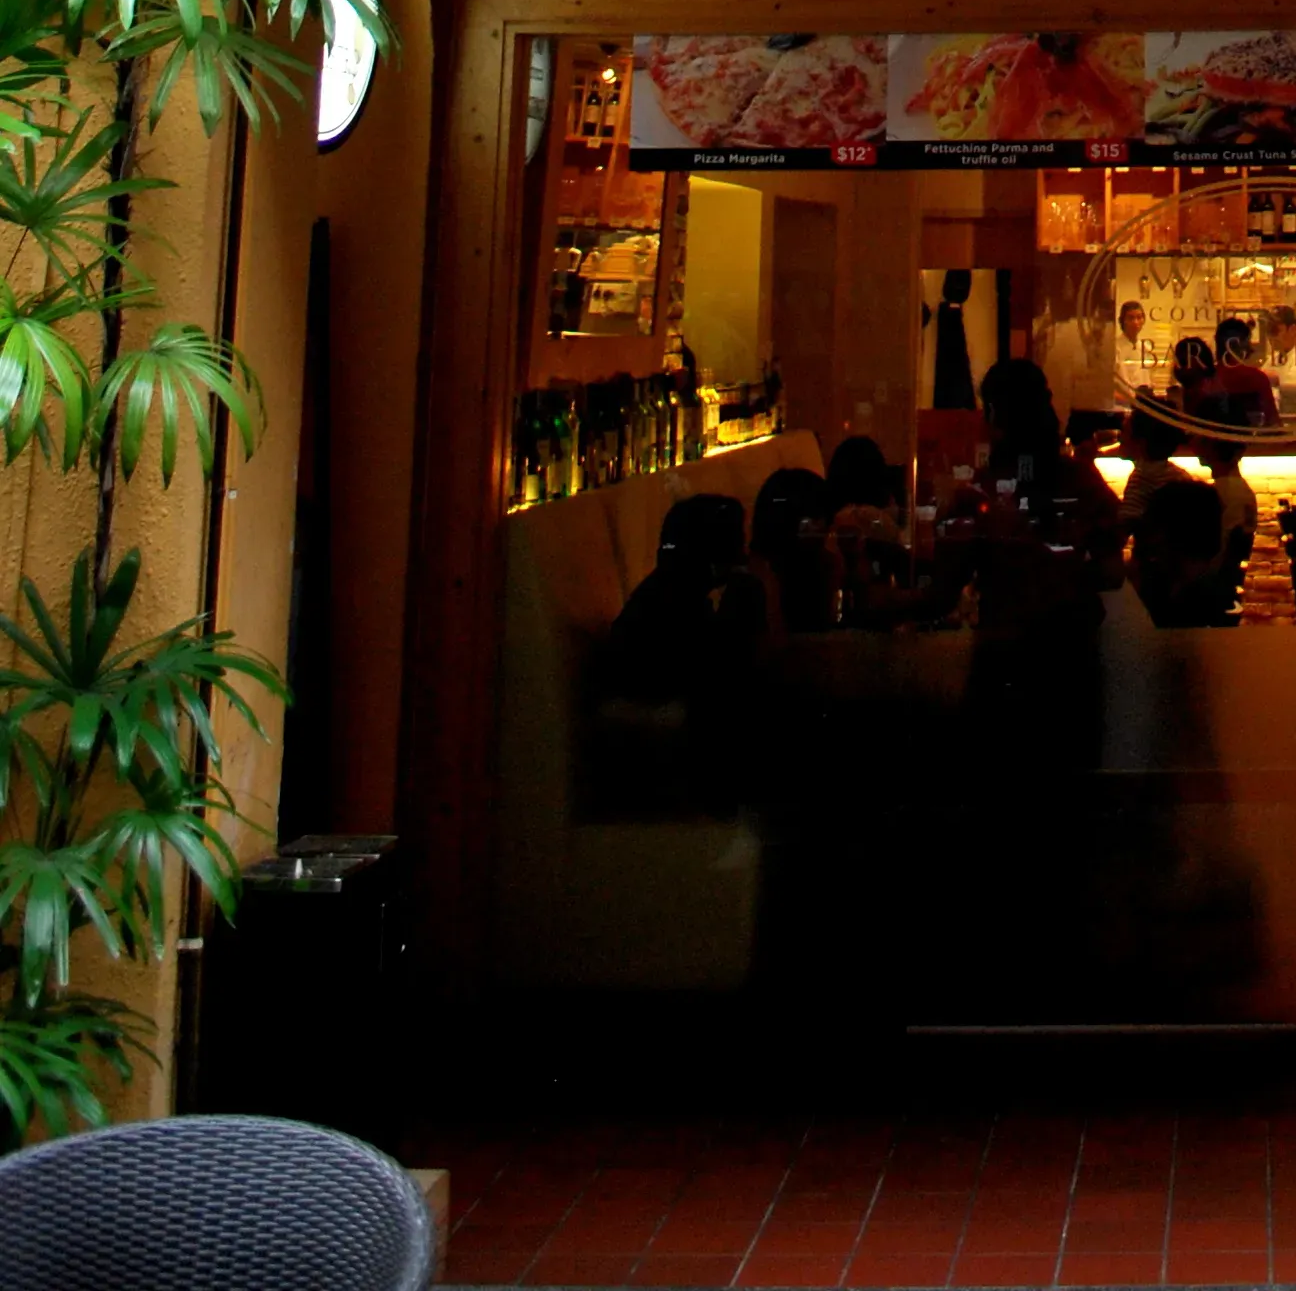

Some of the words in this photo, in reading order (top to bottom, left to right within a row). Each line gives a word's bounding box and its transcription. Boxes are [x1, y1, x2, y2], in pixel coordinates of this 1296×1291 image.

[924, 143, 987, 155] Fettuchine
[991, 143, 1028, 154] Parma
[1032, 142, 1055, 153] and
[1173, 150, 1218, 161] Sesame
[1223, 149, 1254, 161] Crust
[1258, 149, 1286, 160] Tuna
[694, 153, 725, 165] Pizza
[729, 152, 785, 167] Margarita
[961, 154, 998, 165] truffle
[1001, 154, 1017, 165] oil
[1222, 336, 1249, 369] &
